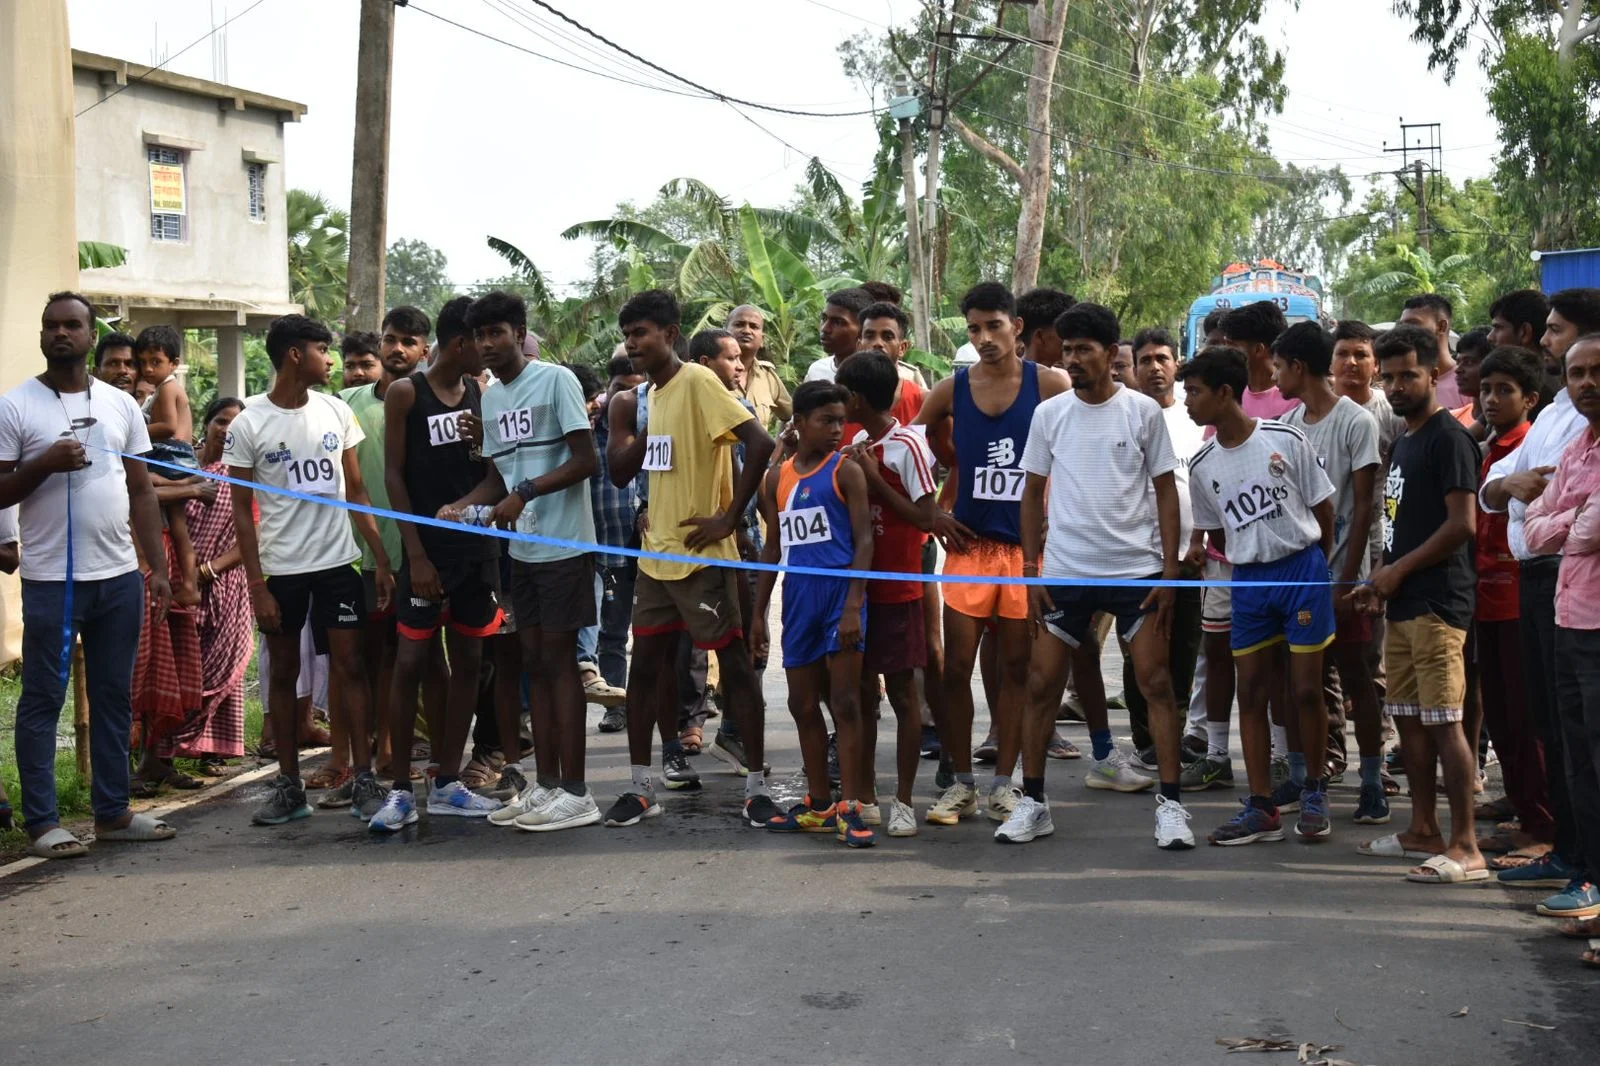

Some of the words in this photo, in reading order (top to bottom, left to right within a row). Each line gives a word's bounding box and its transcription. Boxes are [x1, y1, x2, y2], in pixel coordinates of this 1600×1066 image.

[431, 416, 457, 442] 10
[498, 410, 531, 439] 115
[647, 441, 669, 467] 110
[288, 458, 334, 484] 109
[976, 469, 1025, 496] 107
[1224, 484, 1272, 523] 102
[781, 511, 828, 542] 104
[338, 614, 358, 622] PUMA
